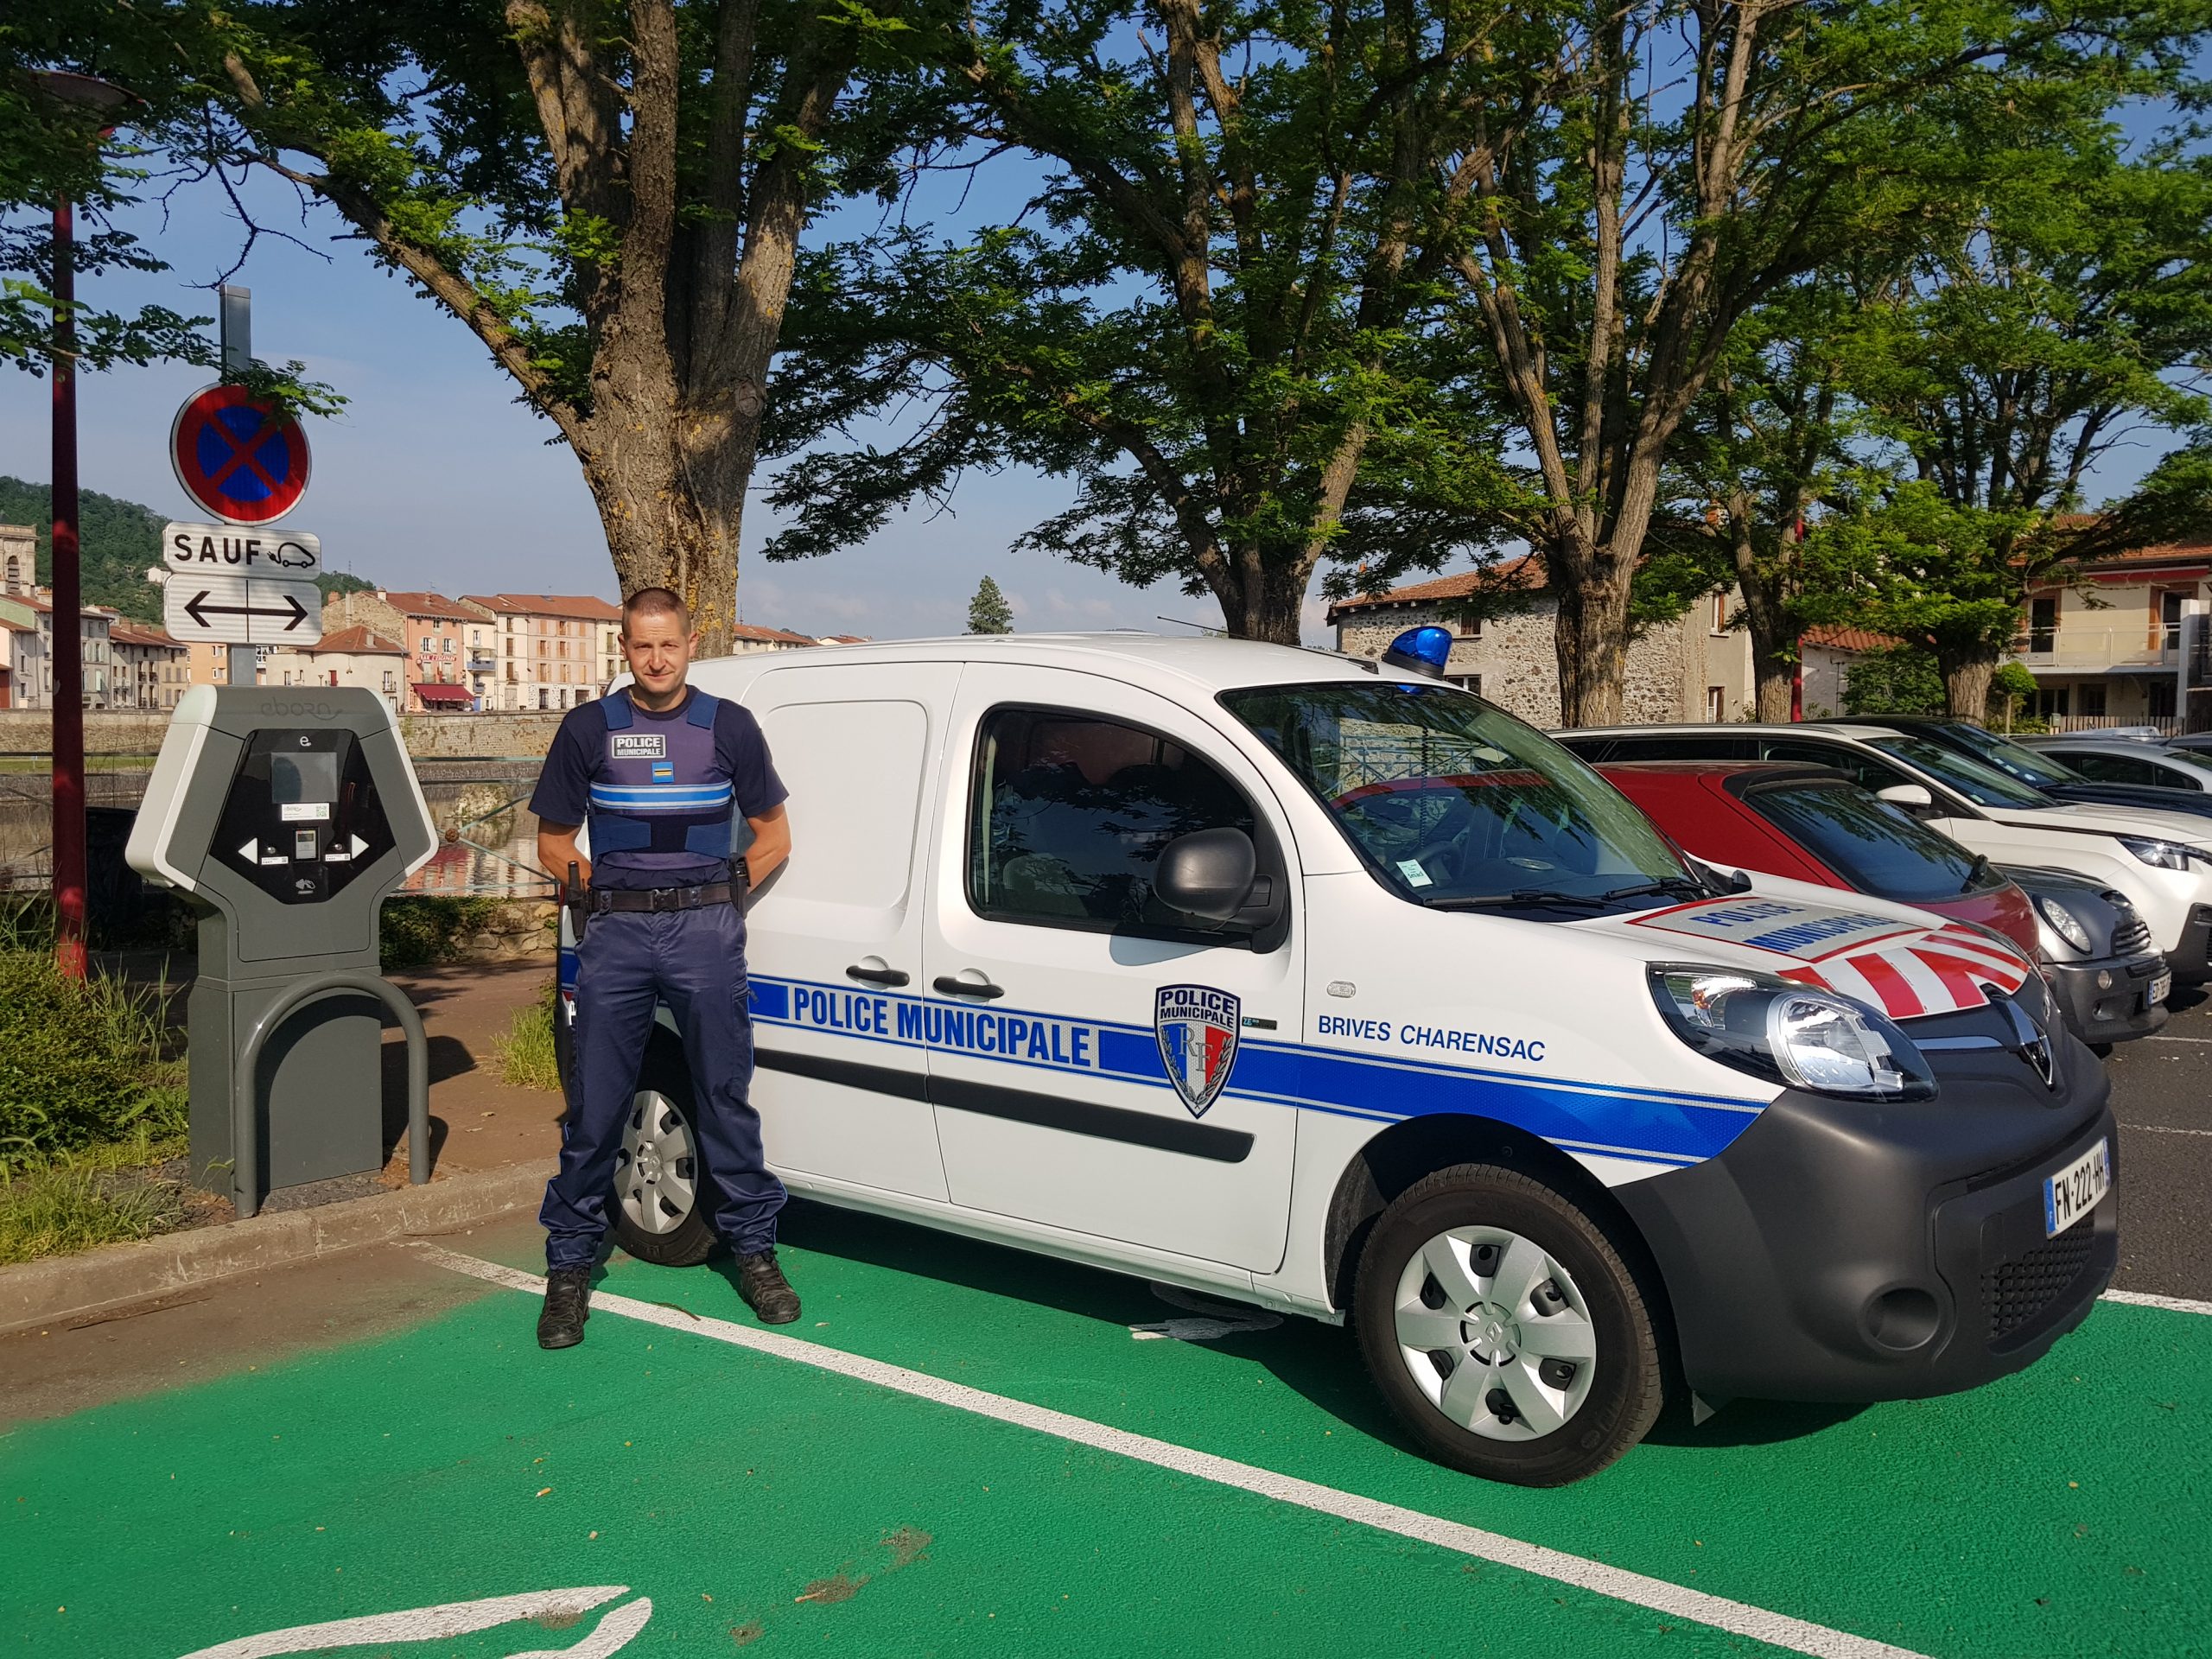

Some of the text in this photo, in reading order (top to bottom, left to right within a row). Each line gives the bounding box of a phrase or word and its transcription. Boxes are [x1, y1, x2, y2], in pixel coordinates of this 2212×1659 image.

[174, 533, 261, 565] SAUF
[616, 737, 661, 748] POLICE
[616, 747, 661, 756] MUNICIPALE
[1688, 903, 1806, 927] POLICE
[1742, 913, 1899, 952] MUNICIPALE
[1160, 989, 1235, 1017] POLICE
[794, 987, 1091, 1068] POLICE MUNICIPALE
[1160, 1007, 1235, 1029] MUNICIPALE
[1319, 1015, 1546, 1062] BRIVES CHARENSAC
